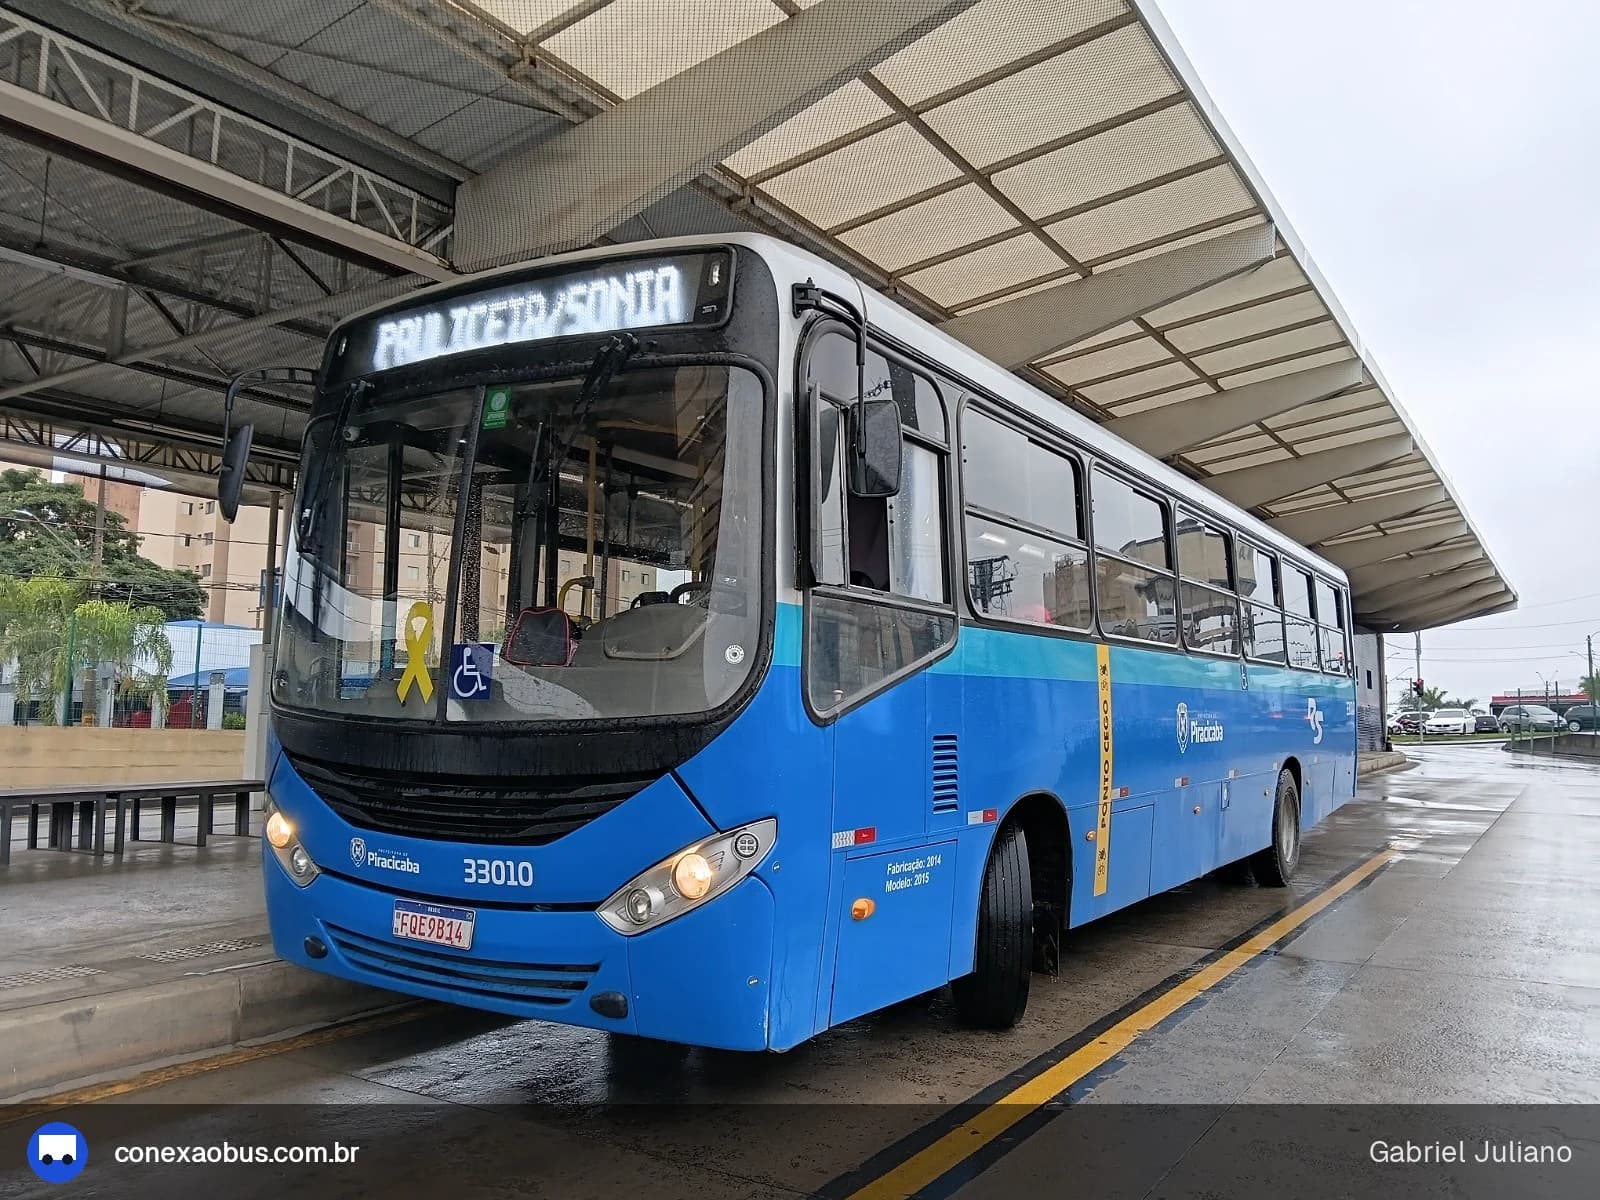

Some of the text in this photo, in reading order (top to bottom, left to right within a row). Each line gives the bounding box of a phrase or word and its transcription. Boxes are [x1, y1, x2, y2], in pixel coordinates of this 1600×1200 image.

[1190, 719, 1224, 743] Piracicaba
[1101, 699, 1110, 828] PONTO CEGO
[367, 851, 420, 874] Piracicaba
[463, 858, 534, 887] 33010
[887, 854, 941, 875] Fabricação: 2014
[885, 872, 929, 893] Modelo: 2015
[400, 913, 463, 943] FQE9B14
